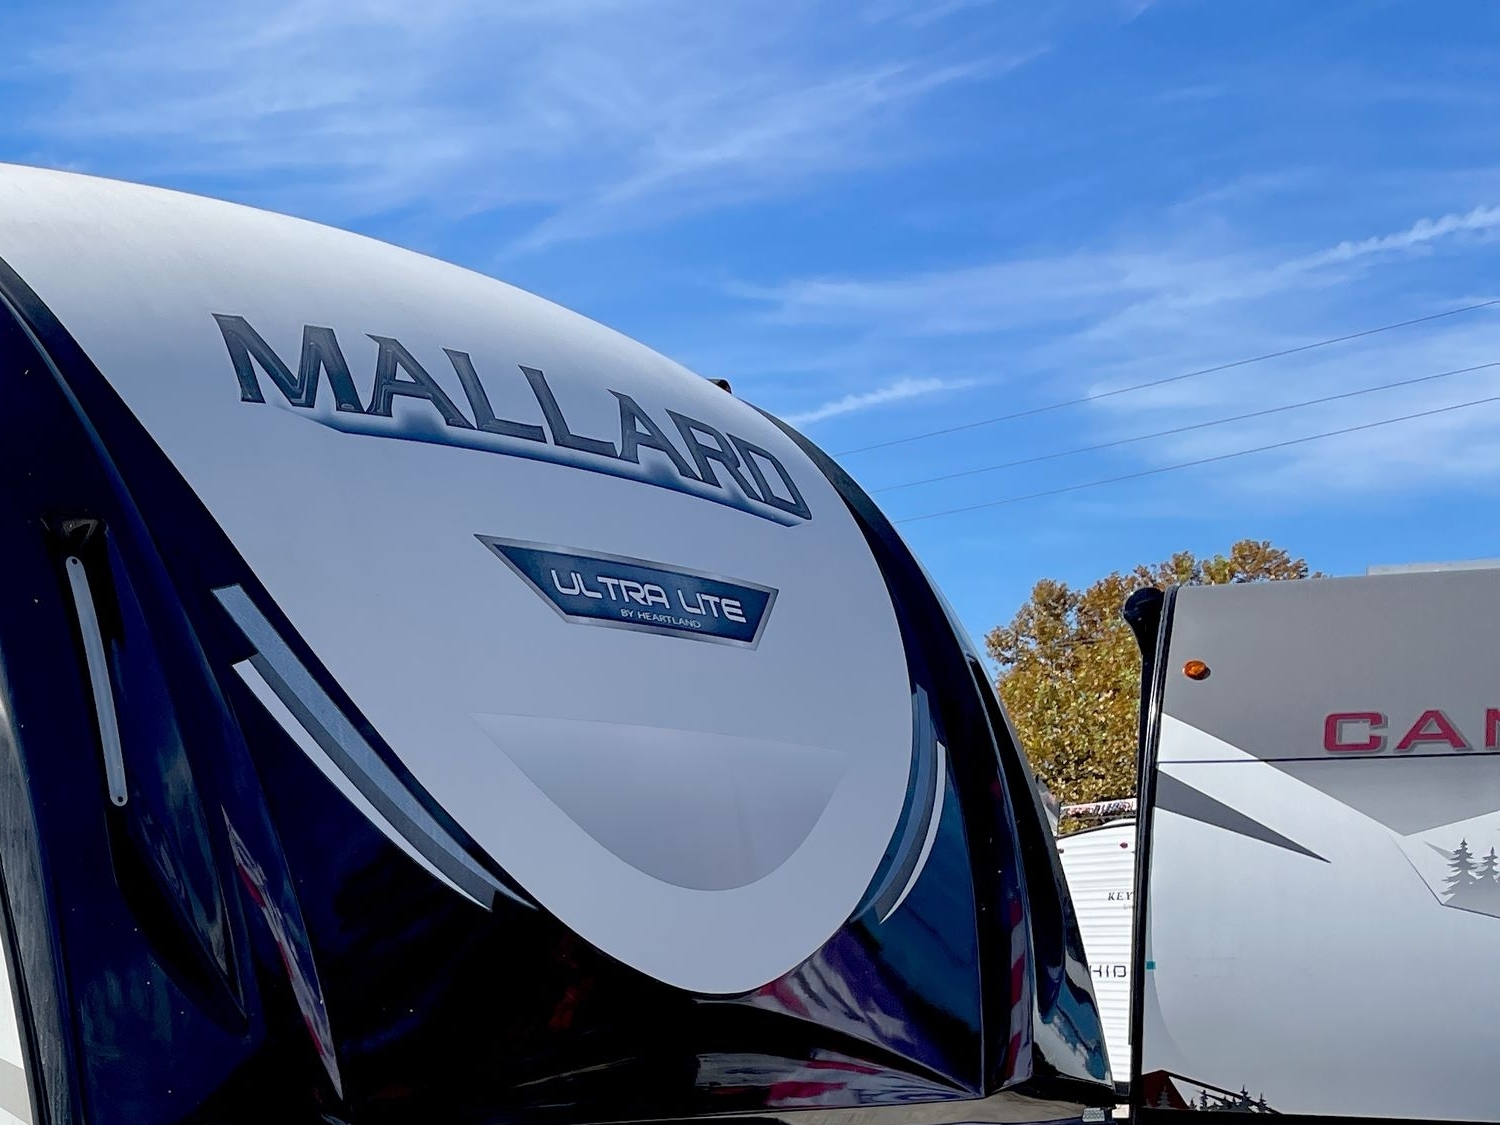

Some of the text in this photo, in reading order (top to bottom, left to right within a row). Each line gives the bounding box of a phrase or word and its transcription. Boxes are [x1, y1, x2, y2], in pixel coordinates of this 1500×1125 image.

[211, 313, 812, 520] MALLARD
[551, 569, 747, 623] ULTRA LITE
[620, 608, 701, 628] BY HEARTLAND
[1324, 708, 1500, 752] CA
